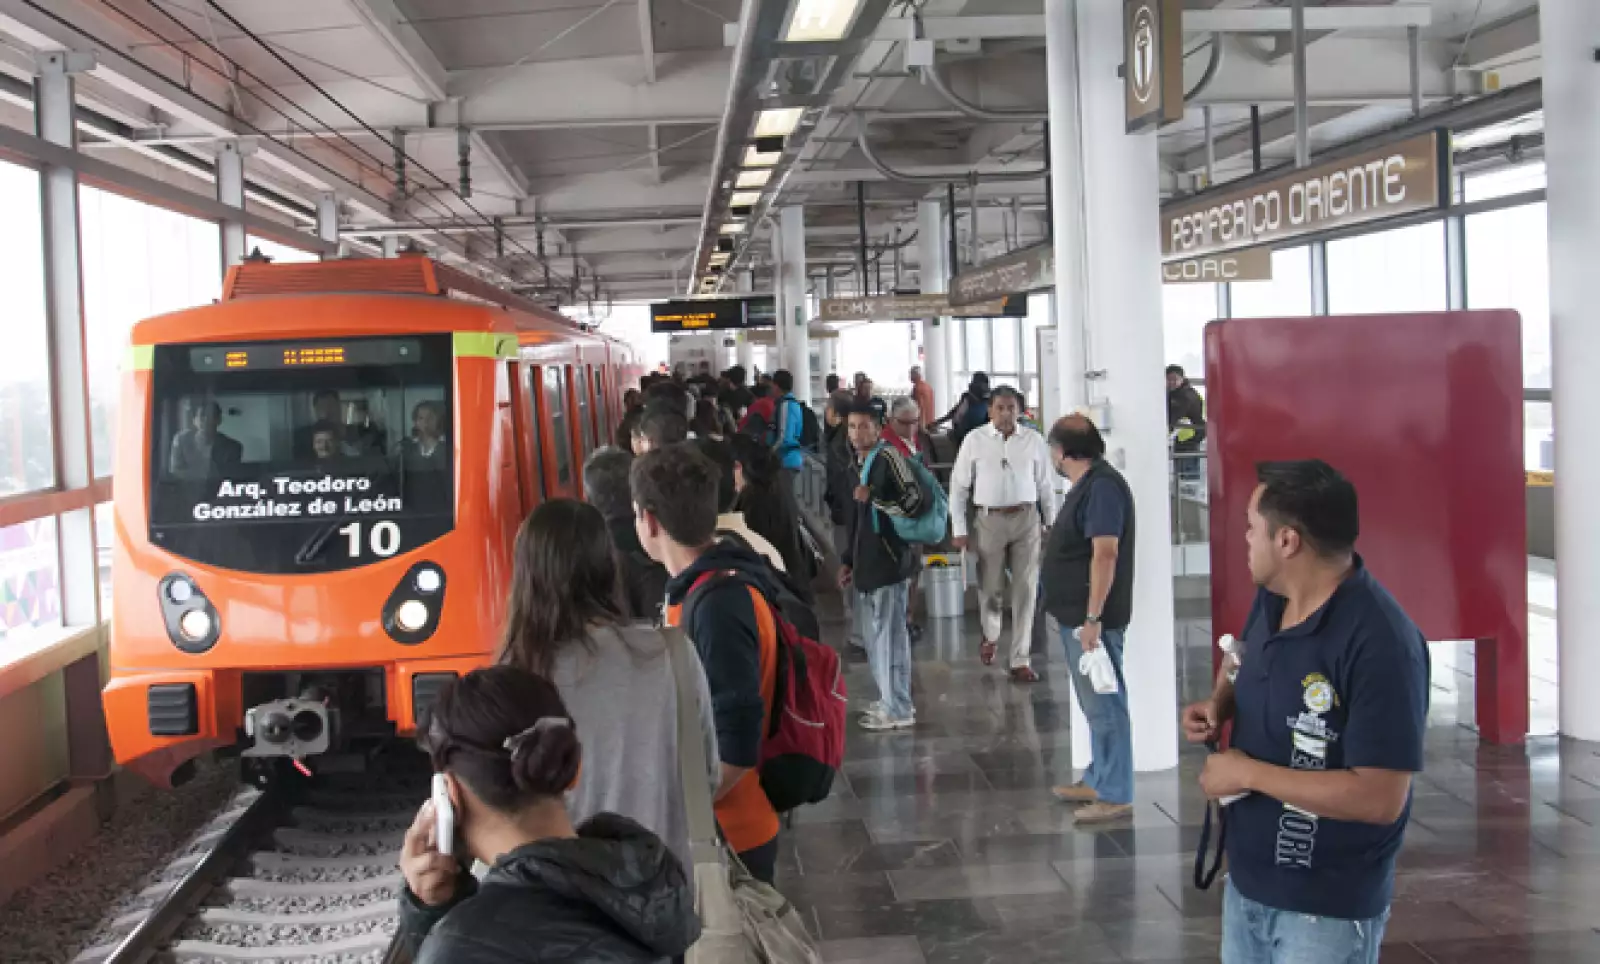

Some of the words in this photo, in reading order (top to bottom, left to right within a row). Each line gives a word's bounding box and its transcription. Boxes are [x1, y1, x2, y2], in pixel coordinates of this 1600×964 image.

[1287, 154, 1406, 226] ORIENTE
[217, 479, 268, 500] Arq.
[272, 474, 372, 496] Teodoro
[192, 499, 302, 521] González
[307, 496, 338, 515] de
[343, 493, 403, 514] León
[339, 520, 401, 558] 10
